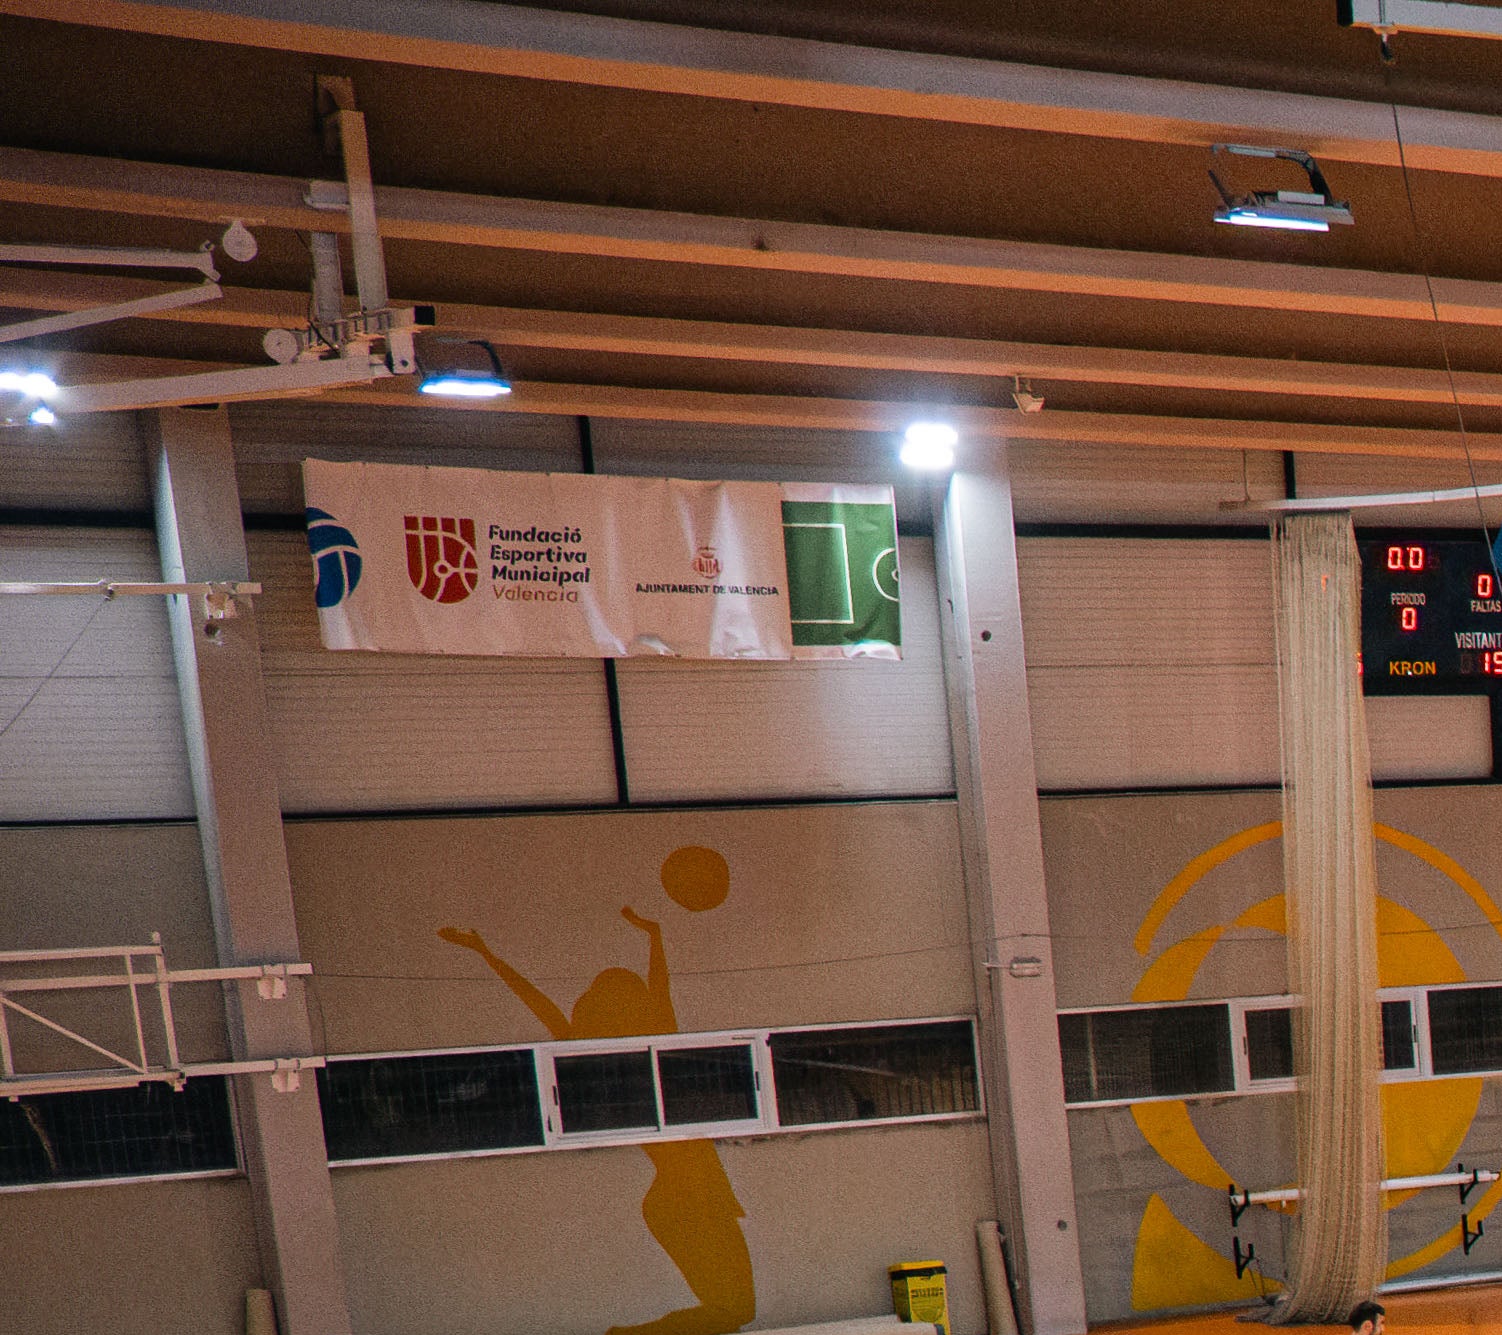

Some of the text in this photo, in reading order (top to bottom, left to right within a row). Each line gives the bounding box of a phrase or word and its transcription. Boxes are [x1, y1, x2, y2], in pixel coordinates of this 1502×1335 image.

[488, 524, 582, 543] Fundació
[490, 544, 587, 565] Esportiva
[491, 564, 590, 586] Municipal
[635, 582, 710, 594] AJUNTAMENT
[712, 585, 726, 594] DE
[1477, 574, 1492, 597] 0
[1391, 592, 1426, 606] PERIODO
[1470, 601, 1502, 613] FALTAS
[1402, 607, 1417, 630] 0
[1389, 660, 1437, 676] KRON
